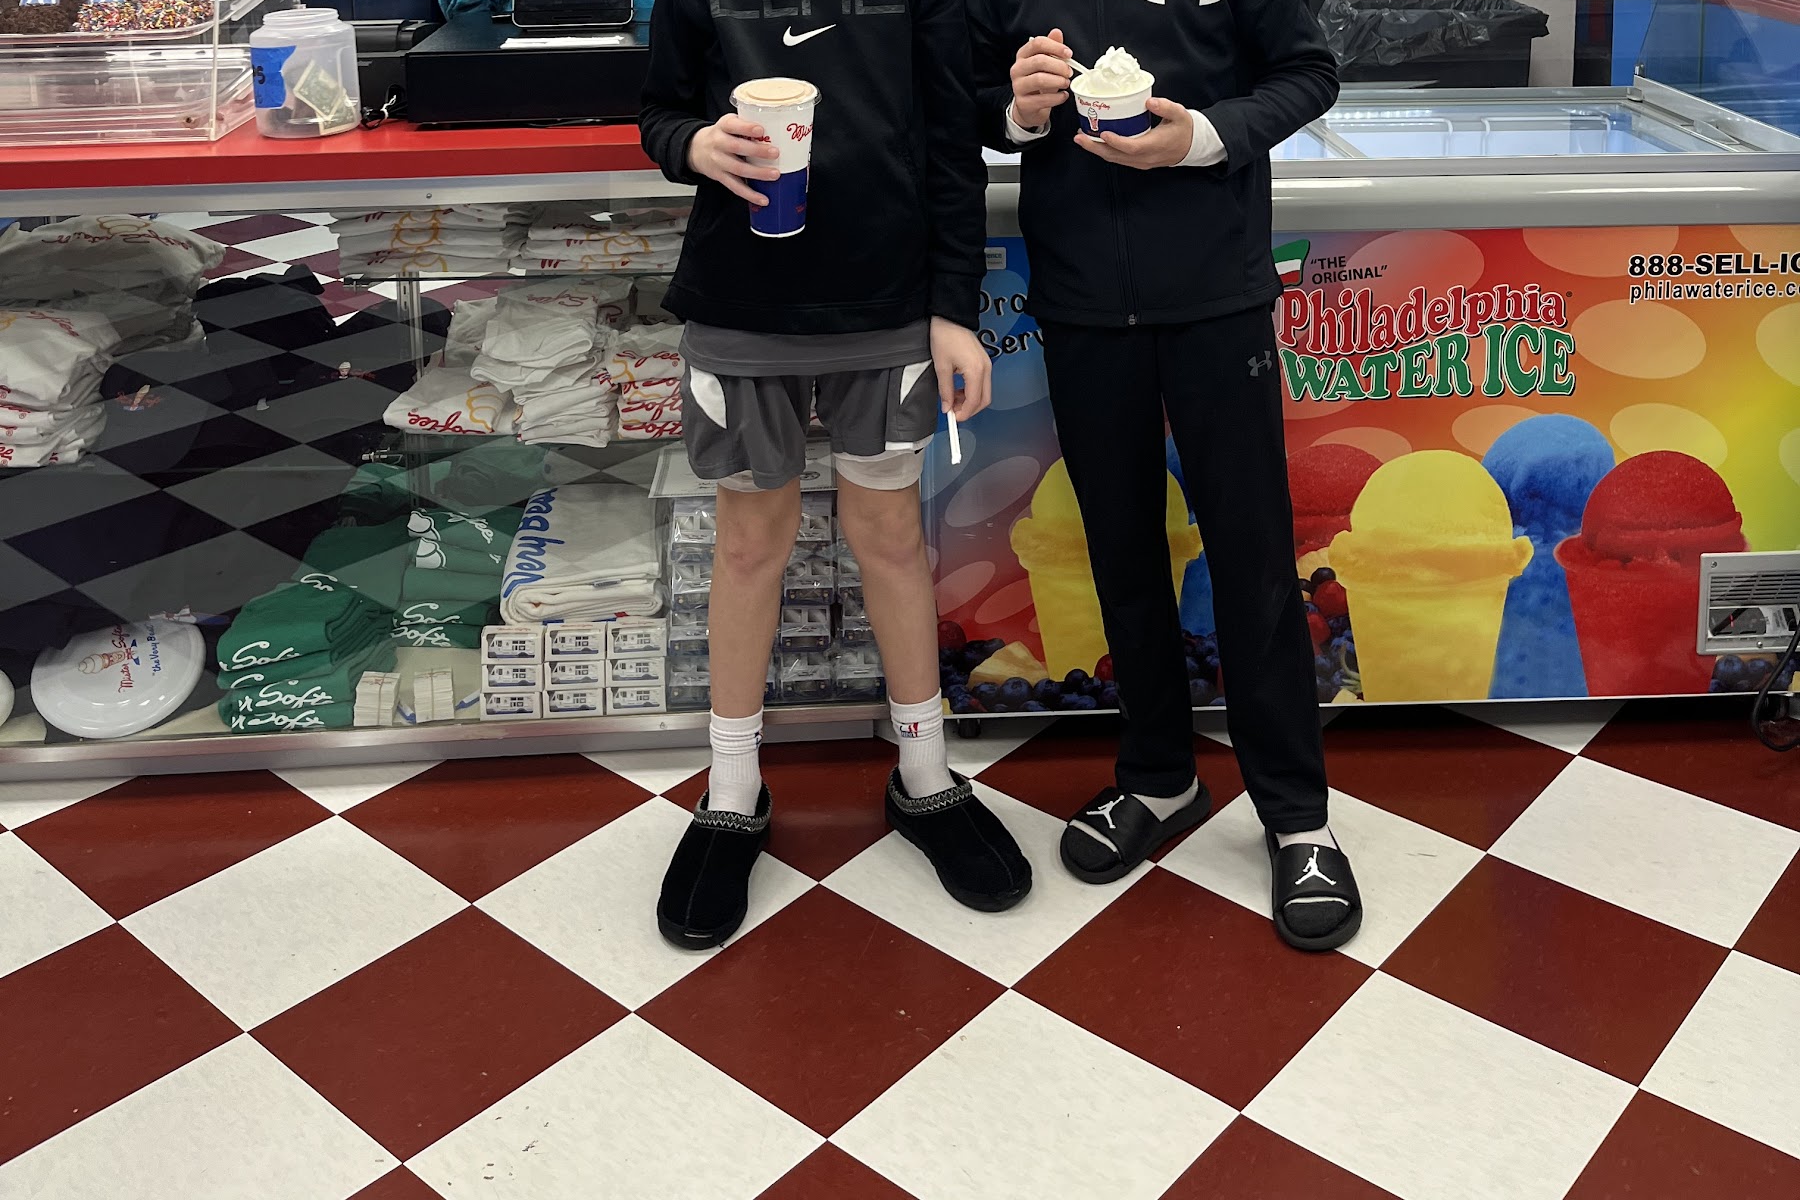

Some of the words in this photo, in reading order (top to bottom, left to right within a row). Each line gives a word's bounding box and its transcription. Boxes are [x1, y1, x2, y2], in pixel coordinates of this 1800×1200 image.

[1312, 265, 1388, 284] ORIGINAL"
[1278, 284, 1567, 355] Philadelphia
[1280, 334, 1472, 401] WATER
[1482, 322, 1577, 398] ICE
